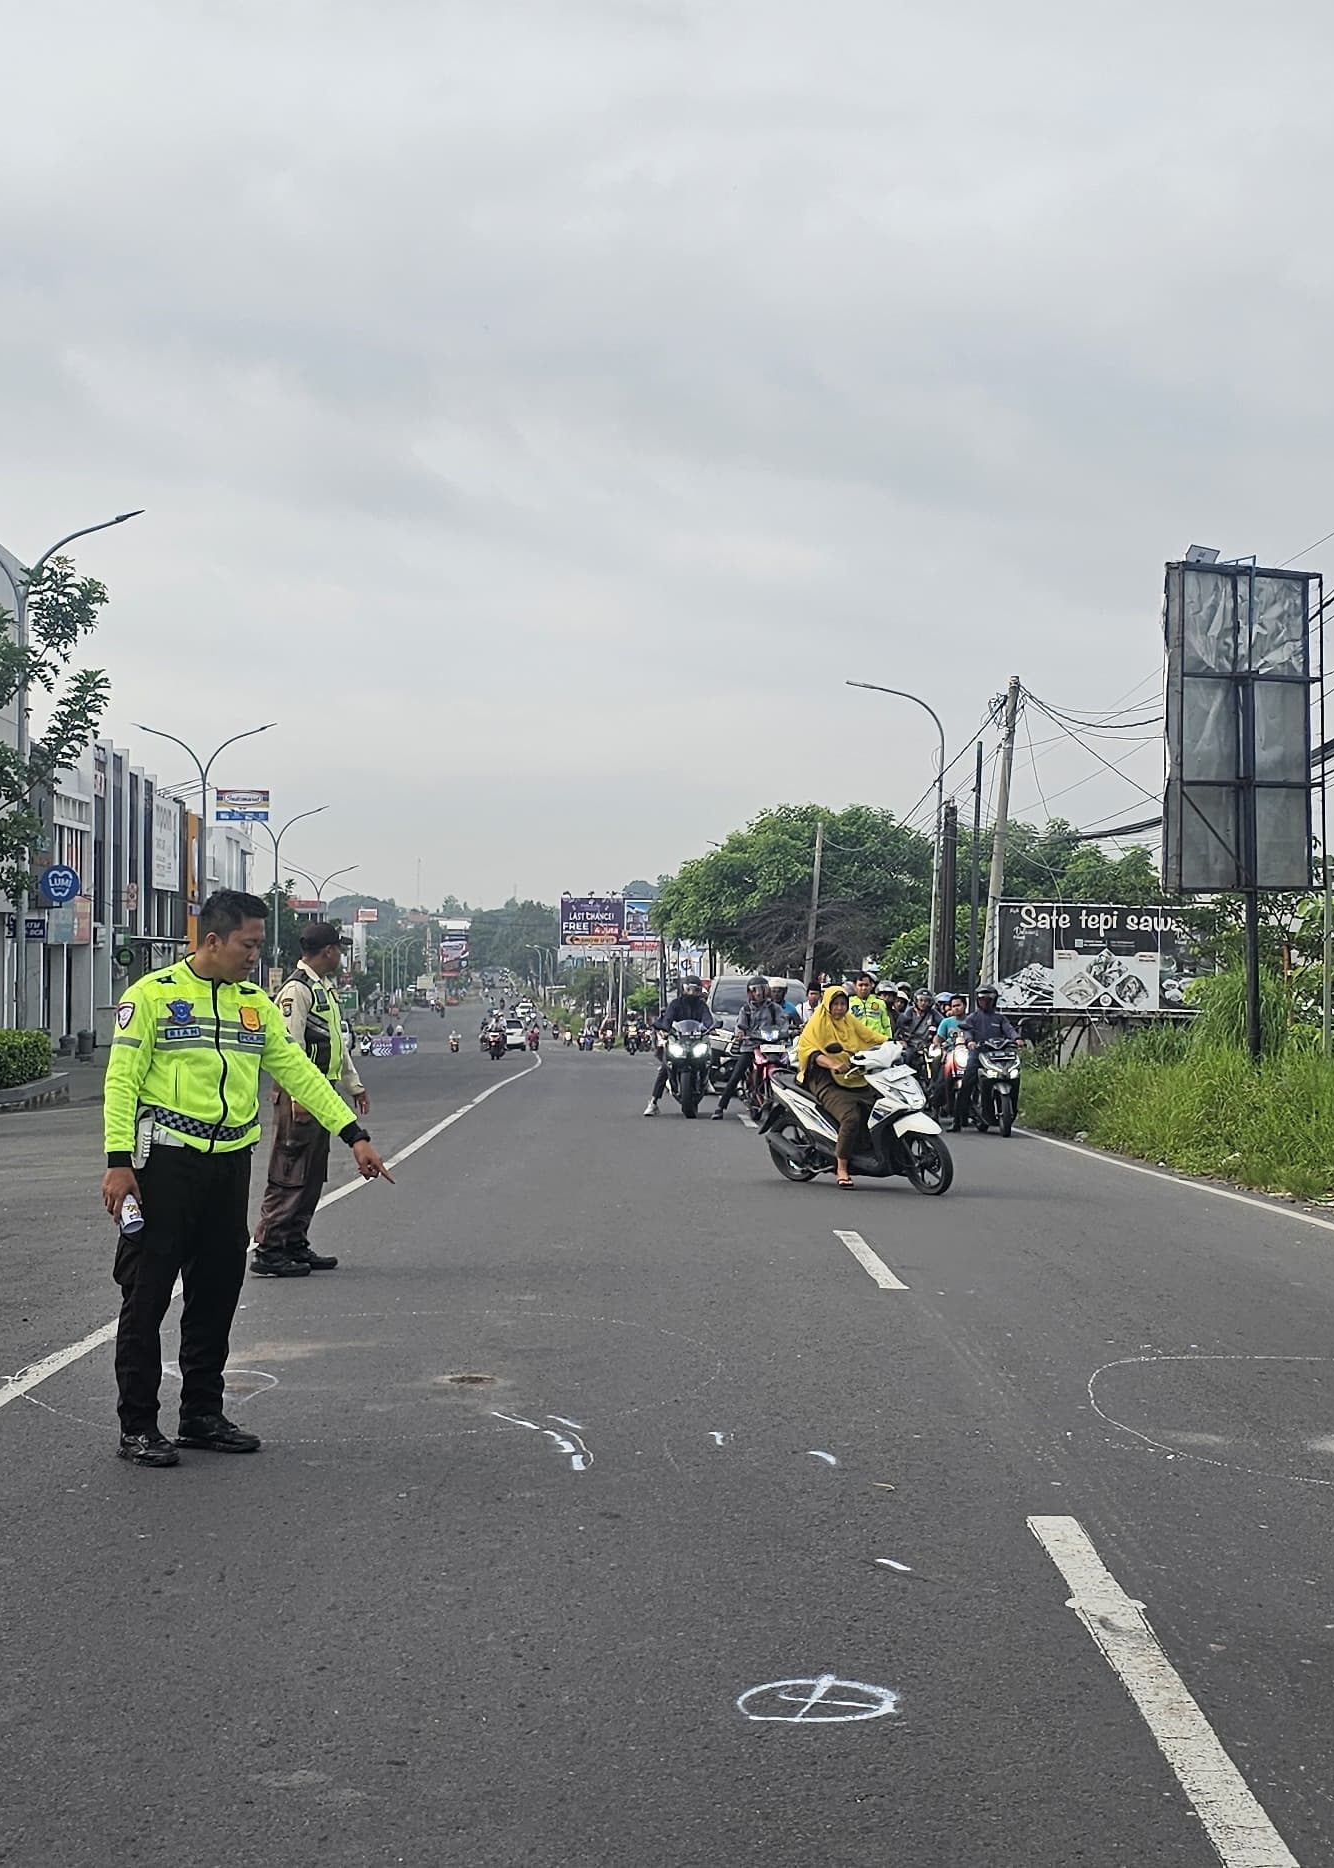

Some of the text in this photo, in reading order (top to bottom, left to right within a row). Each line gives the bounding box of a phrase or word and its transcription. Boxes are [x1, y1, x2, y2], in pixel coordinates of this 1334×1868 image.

[49, 878, 72, 887] LUMI
[569, 912, 614, 921] LAST CHANCE!
[1019, 905, 1190, 937] Sate tepi sawa
[563, 922, 589, 930] FREE
[169, 1028, 198, 1037] RIAN
